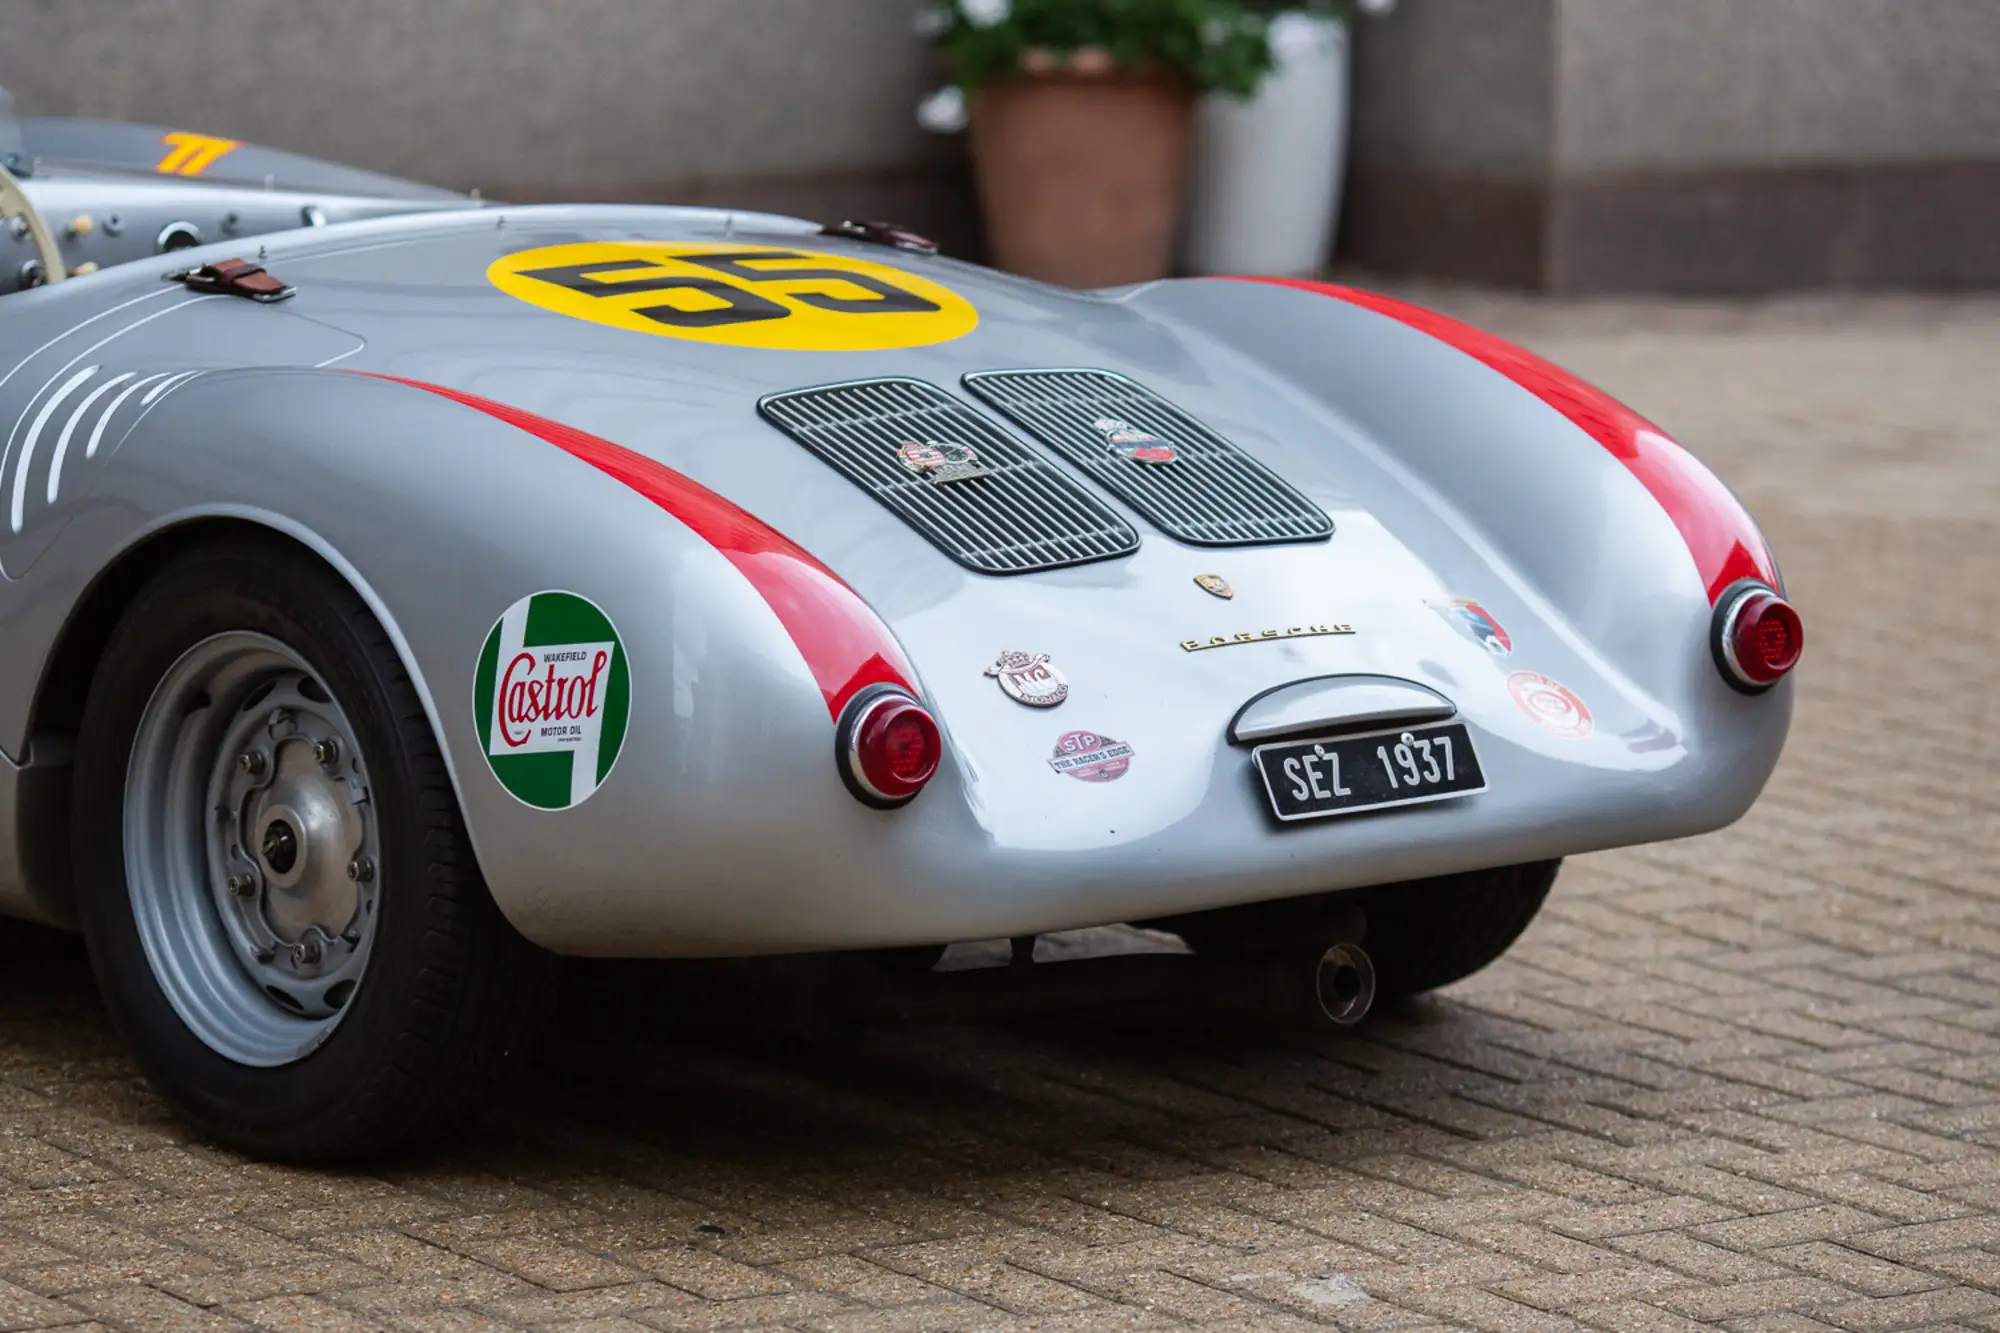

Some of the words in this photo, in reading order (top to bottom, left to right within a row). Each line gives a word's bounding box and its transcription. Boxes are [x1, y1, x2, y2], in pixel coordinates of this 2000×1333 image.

[511, 250, 942, 328] 55
[1180, 623, 1355, 652] PORSCHE
[543, 651, 587, 663] WAKEFIELD
[499, 650, 607, 747] Castrol
[1022, 684, 1069, 704] MONACO
[541, 727, 568, 737] MOTOR
[569, 725, 582, 735] OIL
[1064, 733, 1096, 752] STP
[1054, 759, 1073, 769] THE
[1074, 750, 1107, 765] RACER'S
[1107, 745, 1131, 758] EDGE
[1283, 752, 1352, 801] SEZ
[1377, 736, 1455, 789] 1937
